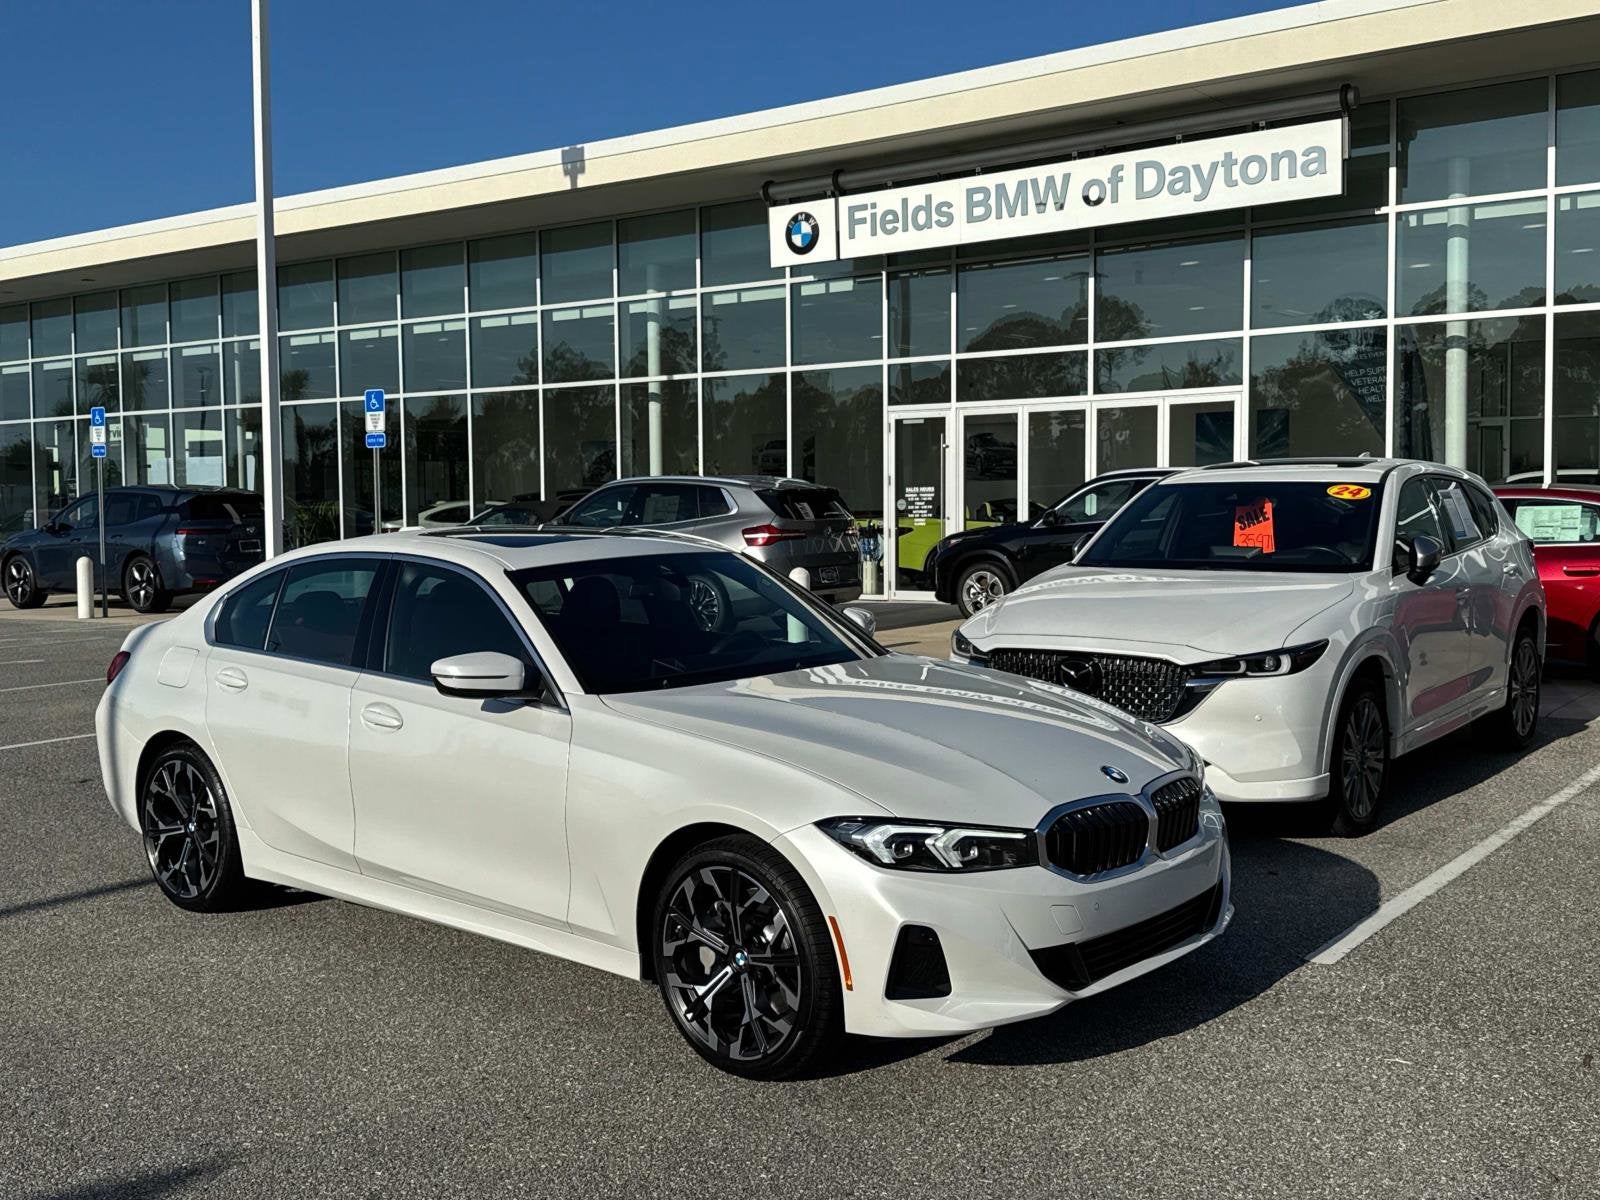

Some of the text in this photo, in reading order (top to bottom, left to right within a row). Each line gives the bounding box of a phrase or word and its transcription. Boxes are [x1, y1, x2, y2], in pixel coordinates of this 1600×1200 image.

[847, 145, 1327, 240] Fields BMW of Daytona
[1344, 368, 1366, 378] HELP
[1351, 375, 1387, 386] VETERAN
[1358, 384, 1387, 395] HEALT
[1336, 486, 1363, 498] 24
[1238, 505, 1270, 531] SALE
